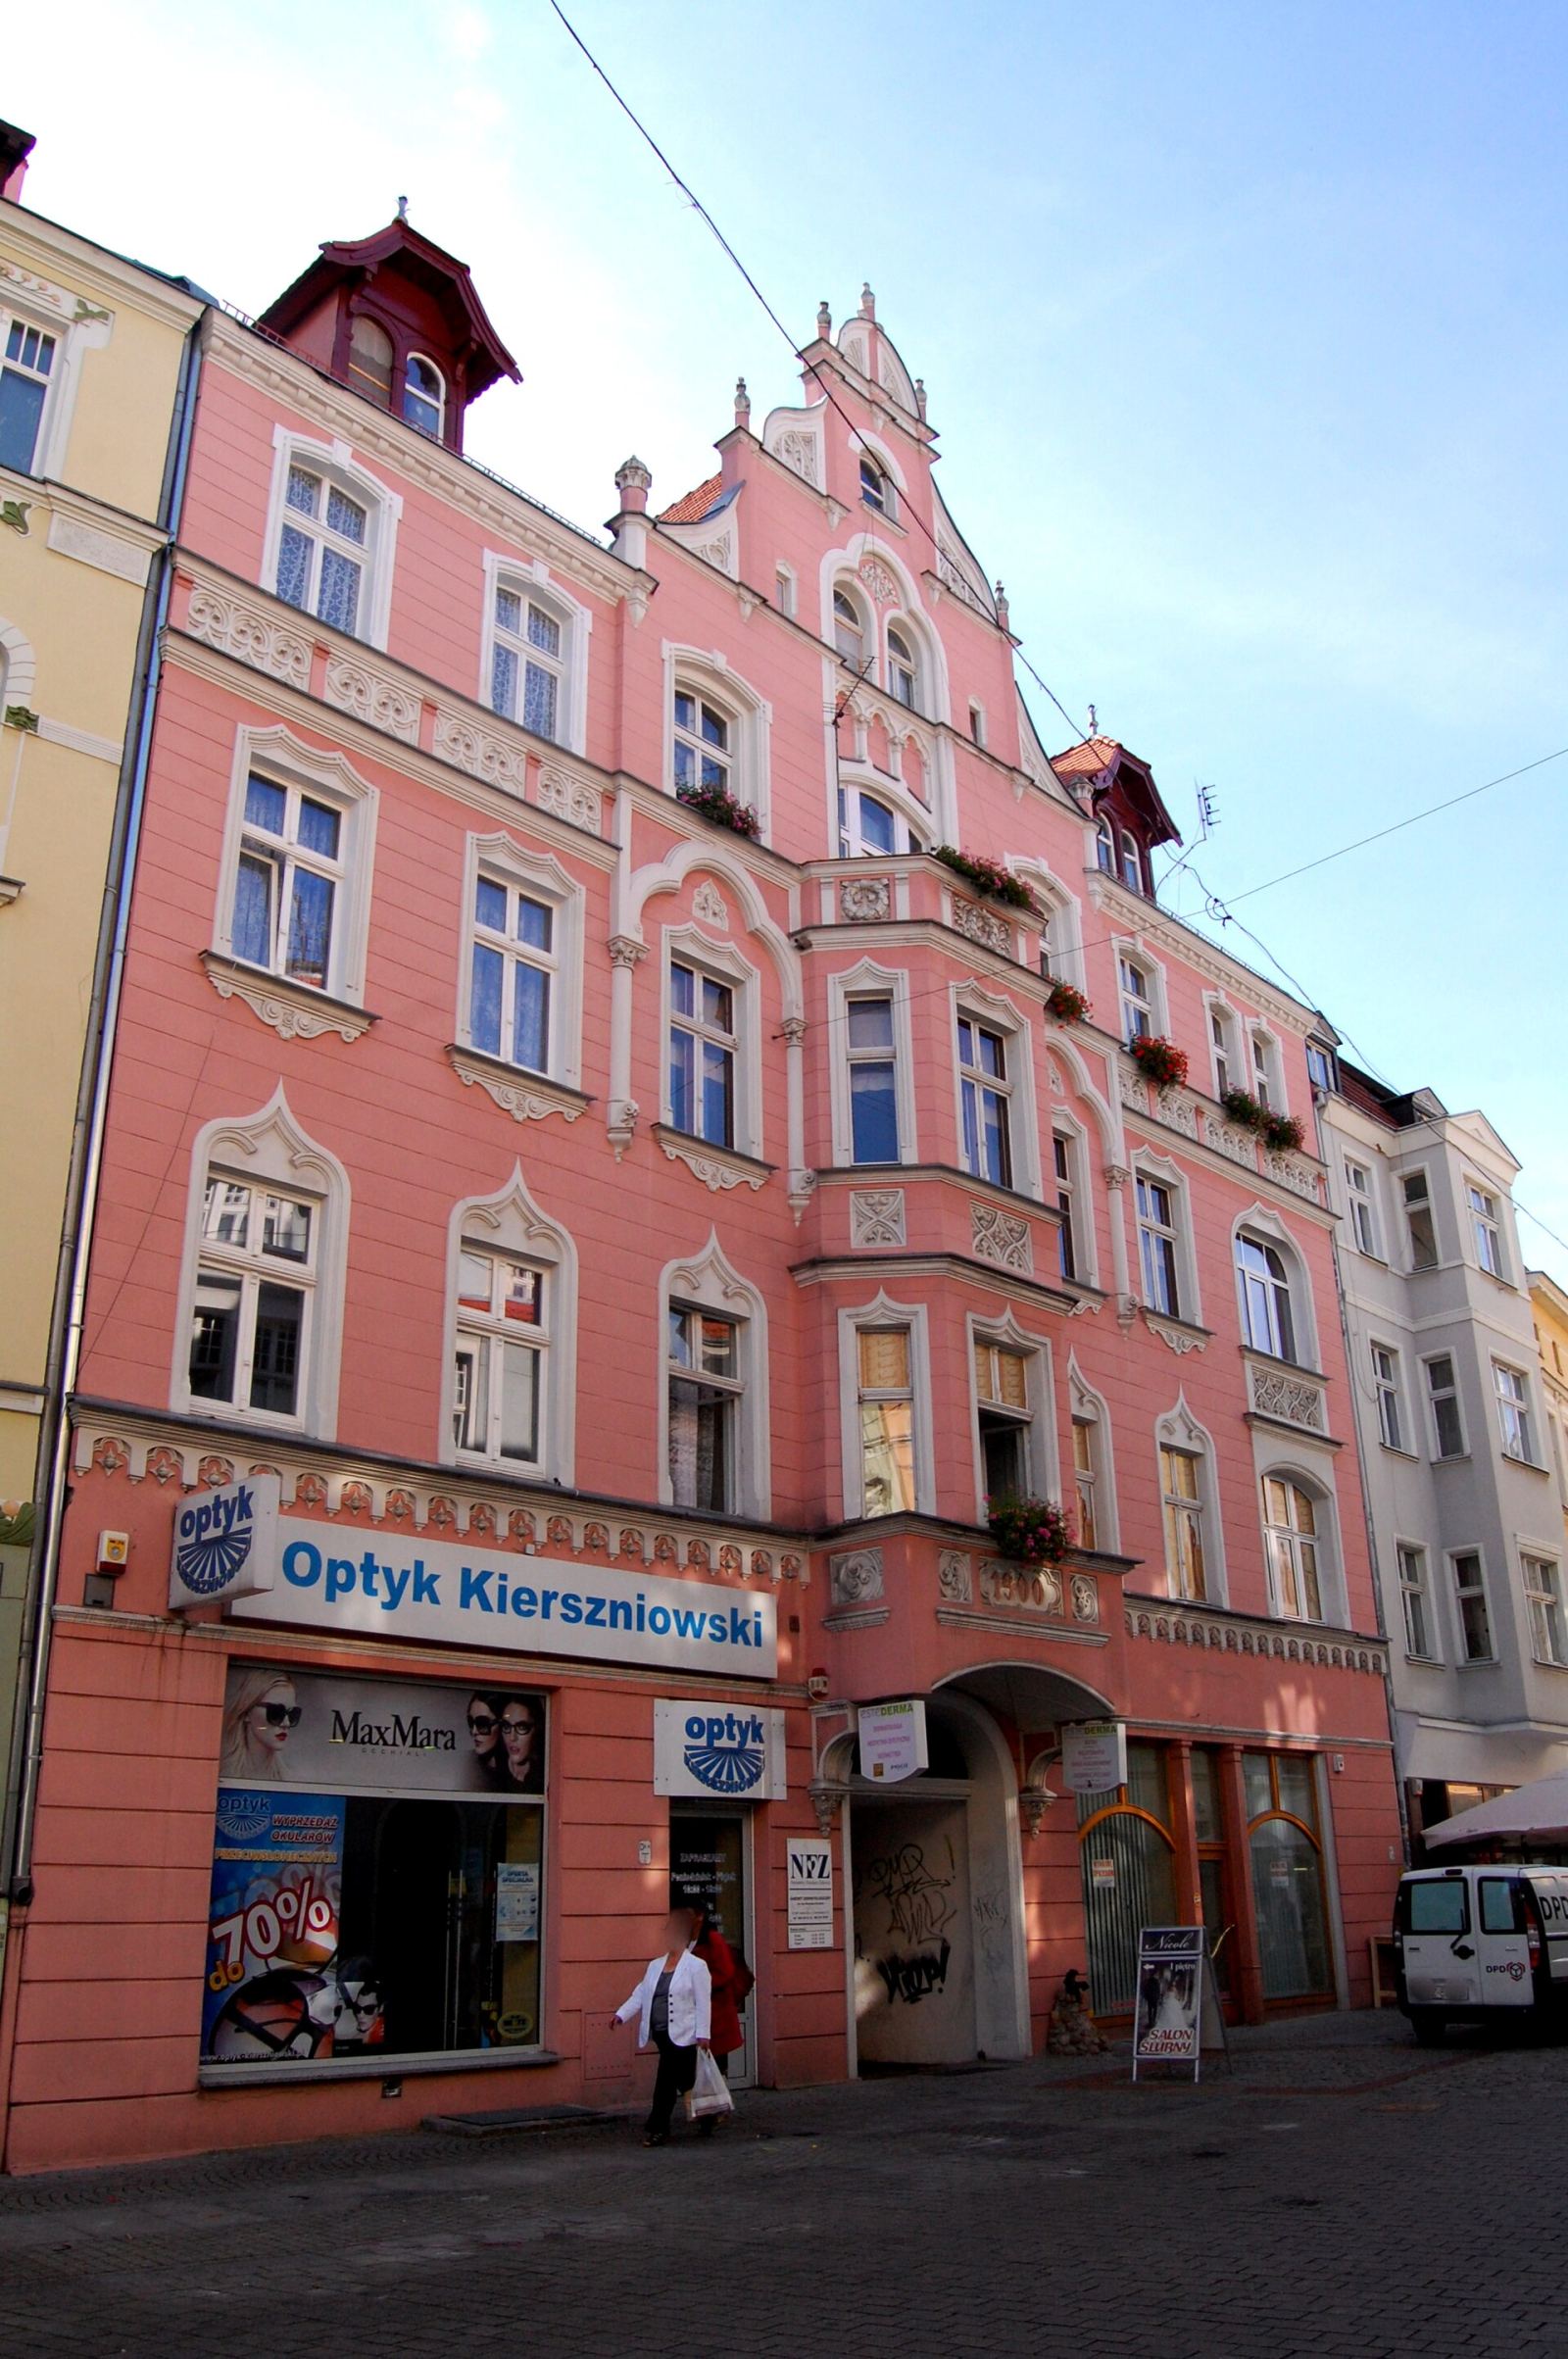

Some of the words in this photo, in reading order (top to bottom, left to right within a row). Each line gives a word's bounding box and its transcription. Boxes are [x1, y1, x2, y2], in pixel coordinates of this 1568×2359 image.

[180, 1485, 254, 1544] optyk
[282, 1541, 441, 1610] Optyk
[459, 1567, 762, 1647] Kierszniowski
[330, 1709, 456, 1751] MaxMara
[685, 1713, 764, 1748] optyk
[218, 1794, 271, 1813] optyk
[791, 1854, 830, 1879] NFZ
[211, 1878, 332, 1965] 70%
[1145, 1932, 1194, 1950] Nicole
[209, 1960, 244, 1991] do
[1486, 1965, 1506, 1974] DPD
[1150, 2029, 1193, 2040] SALON
